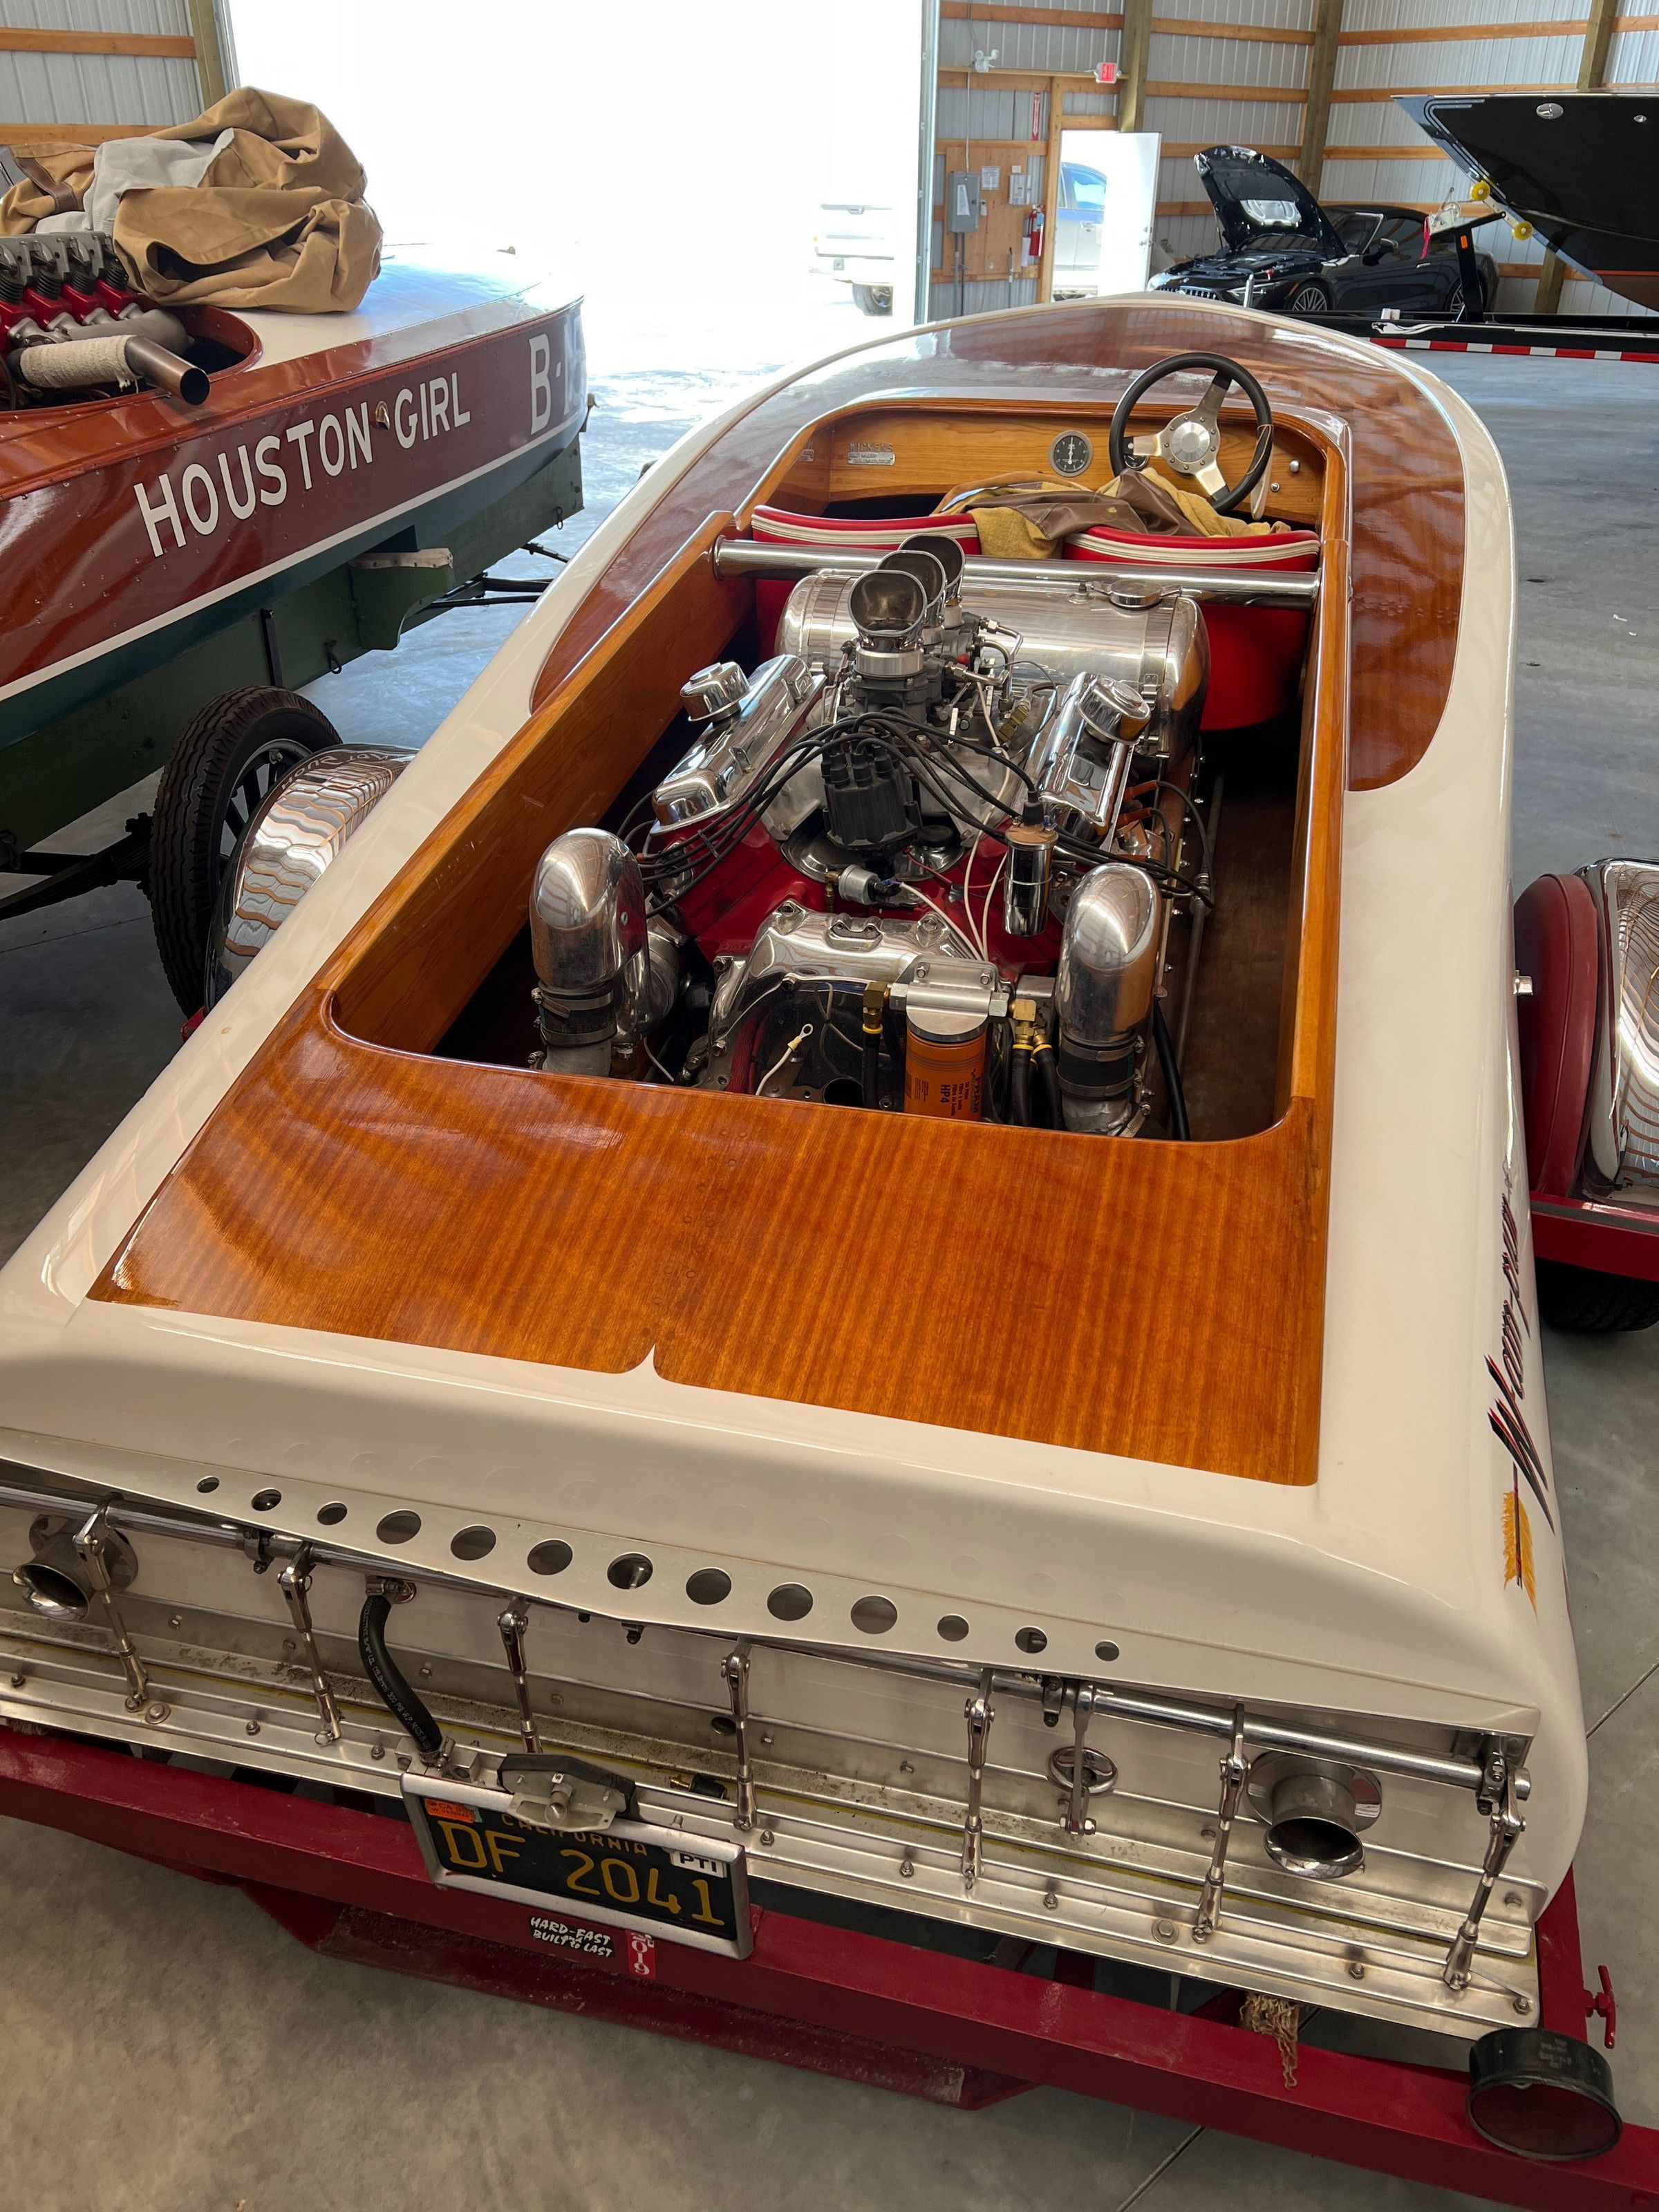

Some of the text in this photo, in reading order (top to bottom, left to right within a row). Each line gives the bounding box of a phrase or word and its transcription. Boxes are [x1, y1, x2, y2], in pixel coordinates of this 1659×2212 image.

[133, 401, 373, 559] HOUSTON
[393, 371, 471, 451] GIRL
[940, 1084, 950, 1104] HP4
[386, 1691, 397, 1703] 300
[437, 1819, 725, 1927] DF 2041
[679, 1855, 718, 1873] PTI
[533, 1929, 565, 1946] BUILT
[583, 1943, 612, 1958] LAST
